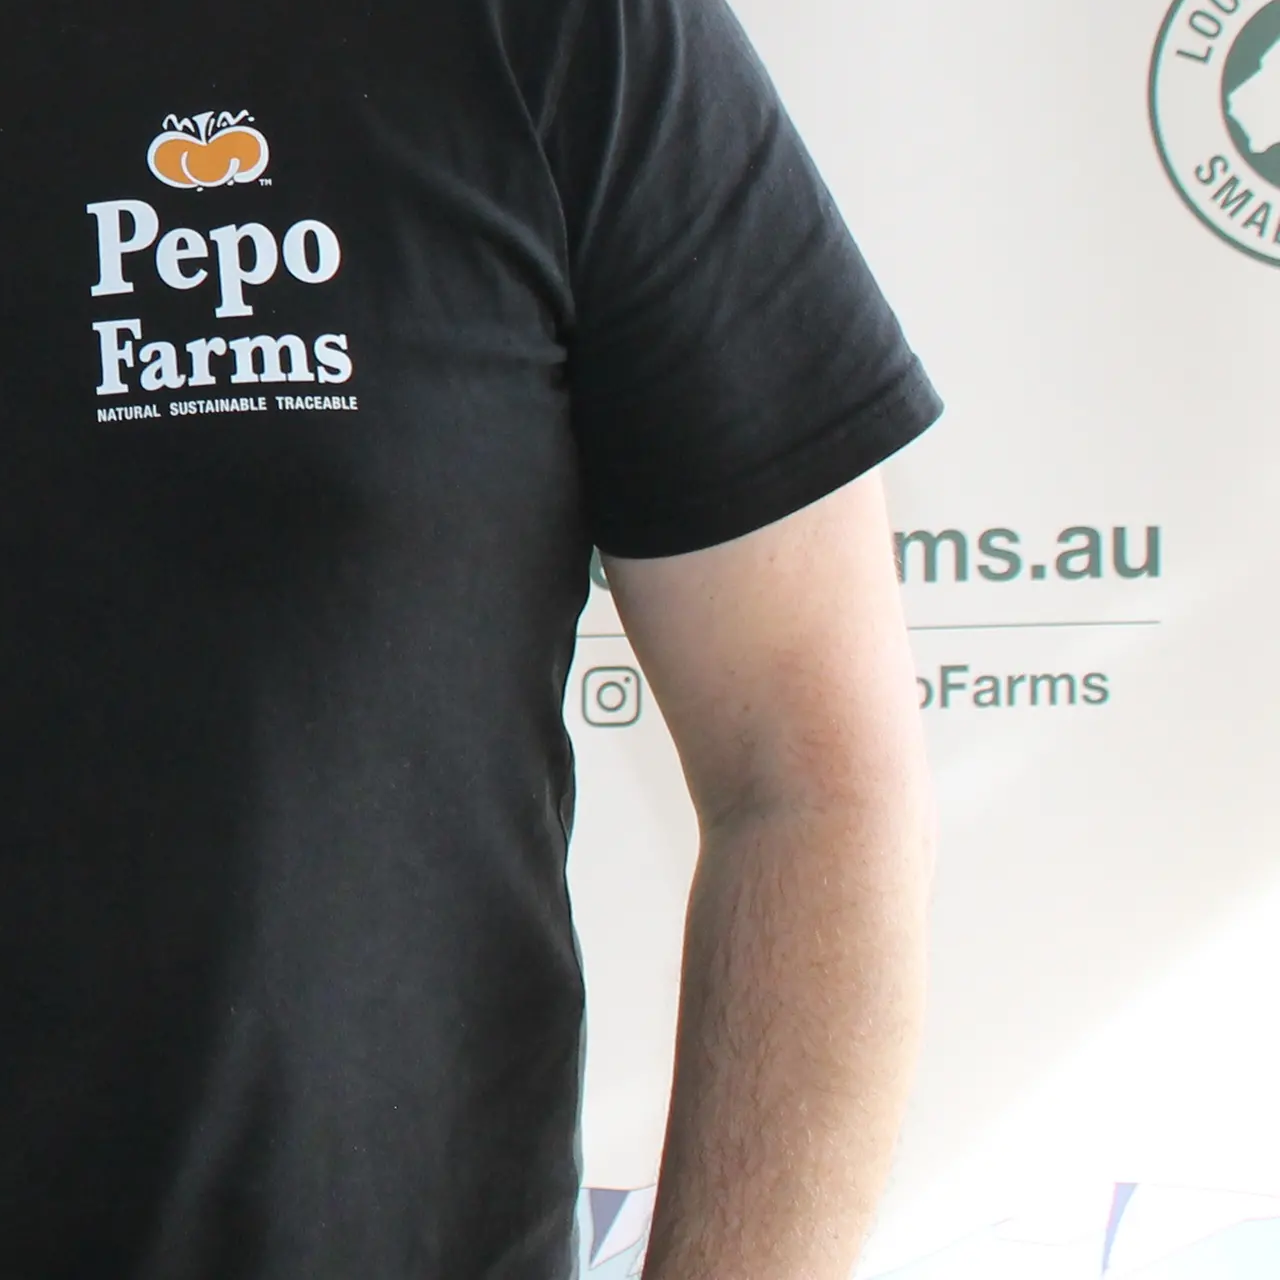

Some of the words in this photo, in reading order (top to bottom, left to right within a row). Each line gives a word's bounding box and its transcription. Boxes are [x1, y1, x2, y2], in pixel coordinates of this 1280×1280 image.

[86, 199, 341, 318] Pepo
[92, 318, 353, 396] Farms
[96, 404, 161, 423] NATURAL
[169, 396, 267, 417] SUSTAINABLE
[275, 395, 358, 411] TRACEABLE
[893, 524, 1161, 583] ms.au
